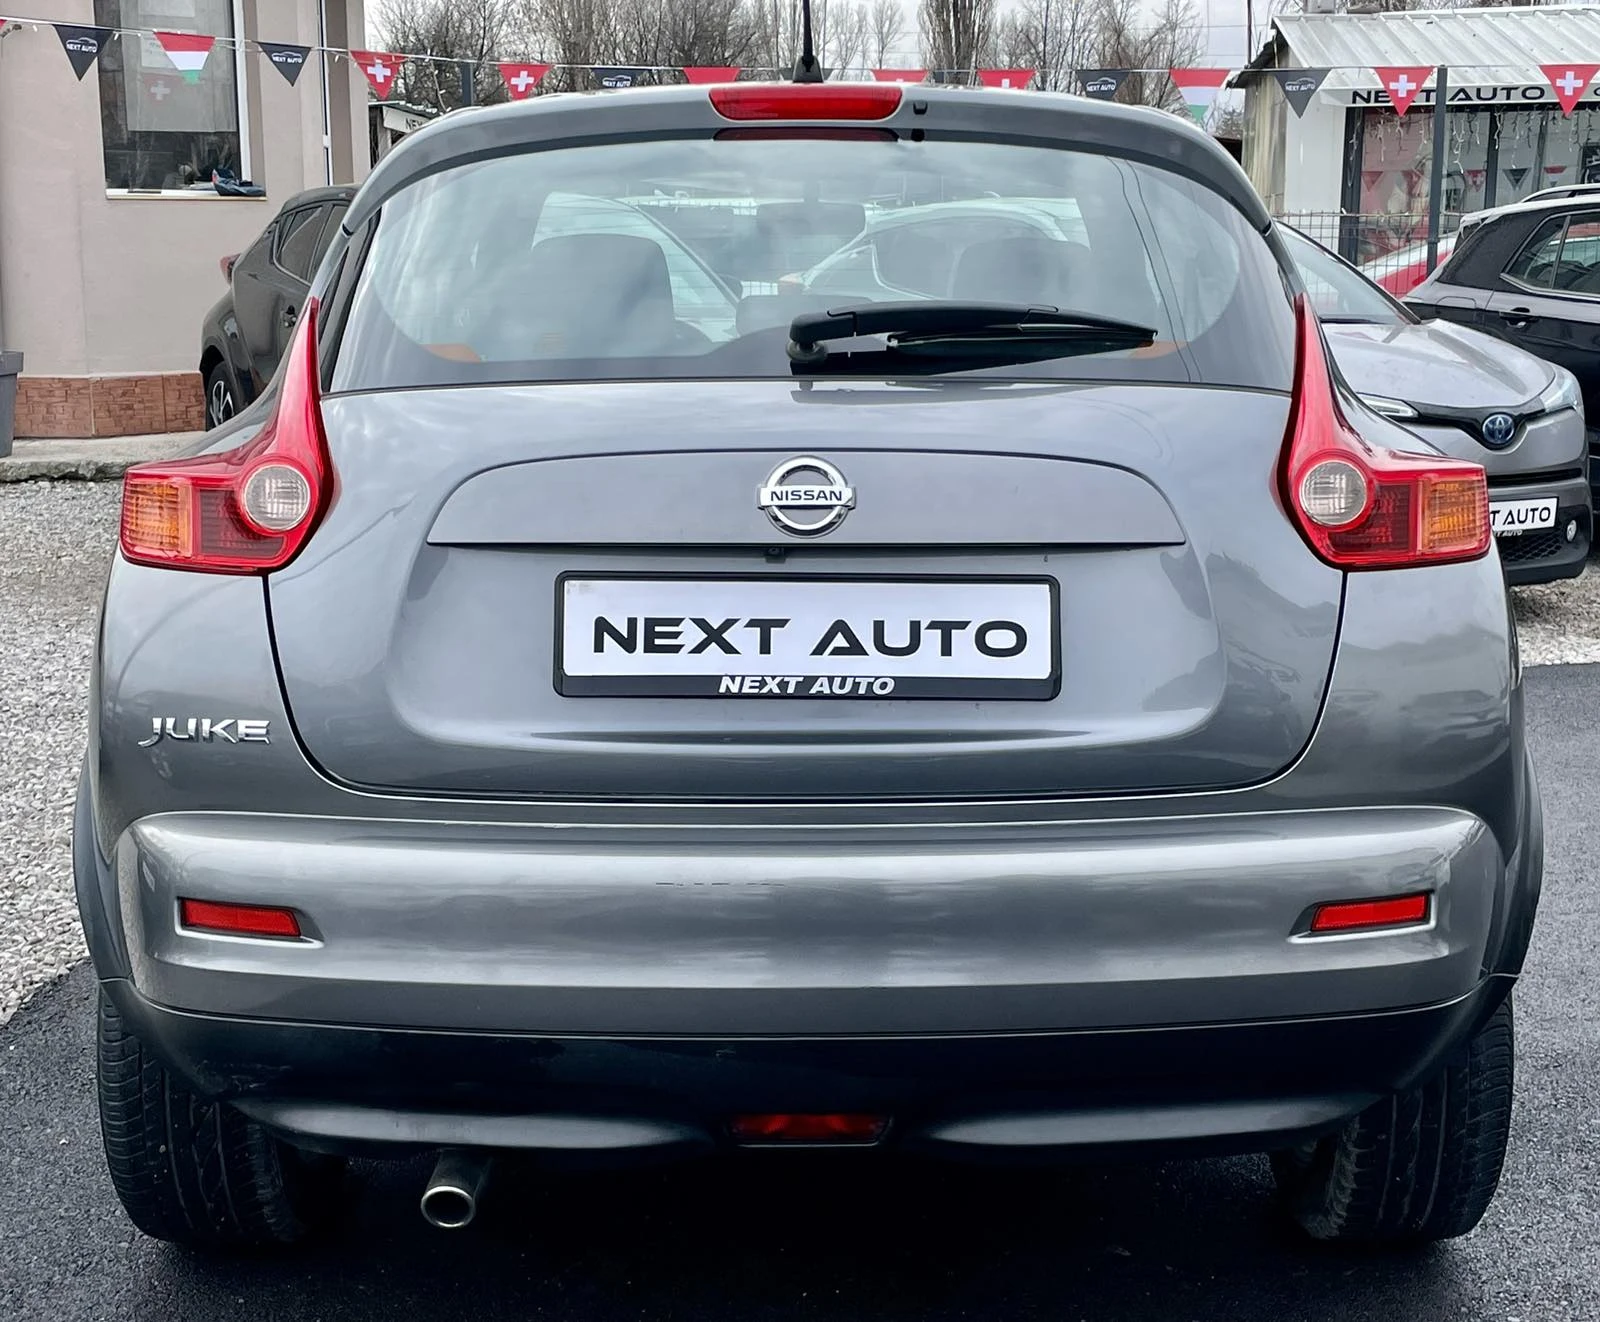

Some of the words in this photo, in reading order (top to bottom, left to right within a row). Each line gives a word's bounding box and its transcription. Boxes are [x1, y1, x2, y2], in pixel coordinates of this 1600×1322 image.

[1351, 89, 1437, 104] NET
[1448, 86, 1545, 101] AUTO
[770, 490, 842, 501] NISSAN
[1502, 506, 1551, 525] AUTO
[594, 616, 791, 655] NEXT
[809, 619, 1027, 657] AUTO
[719, 676, 804, 694] NEXT
[808, 676, 895, 695] AUTO
[137, 717, 271, 748] JUKE
